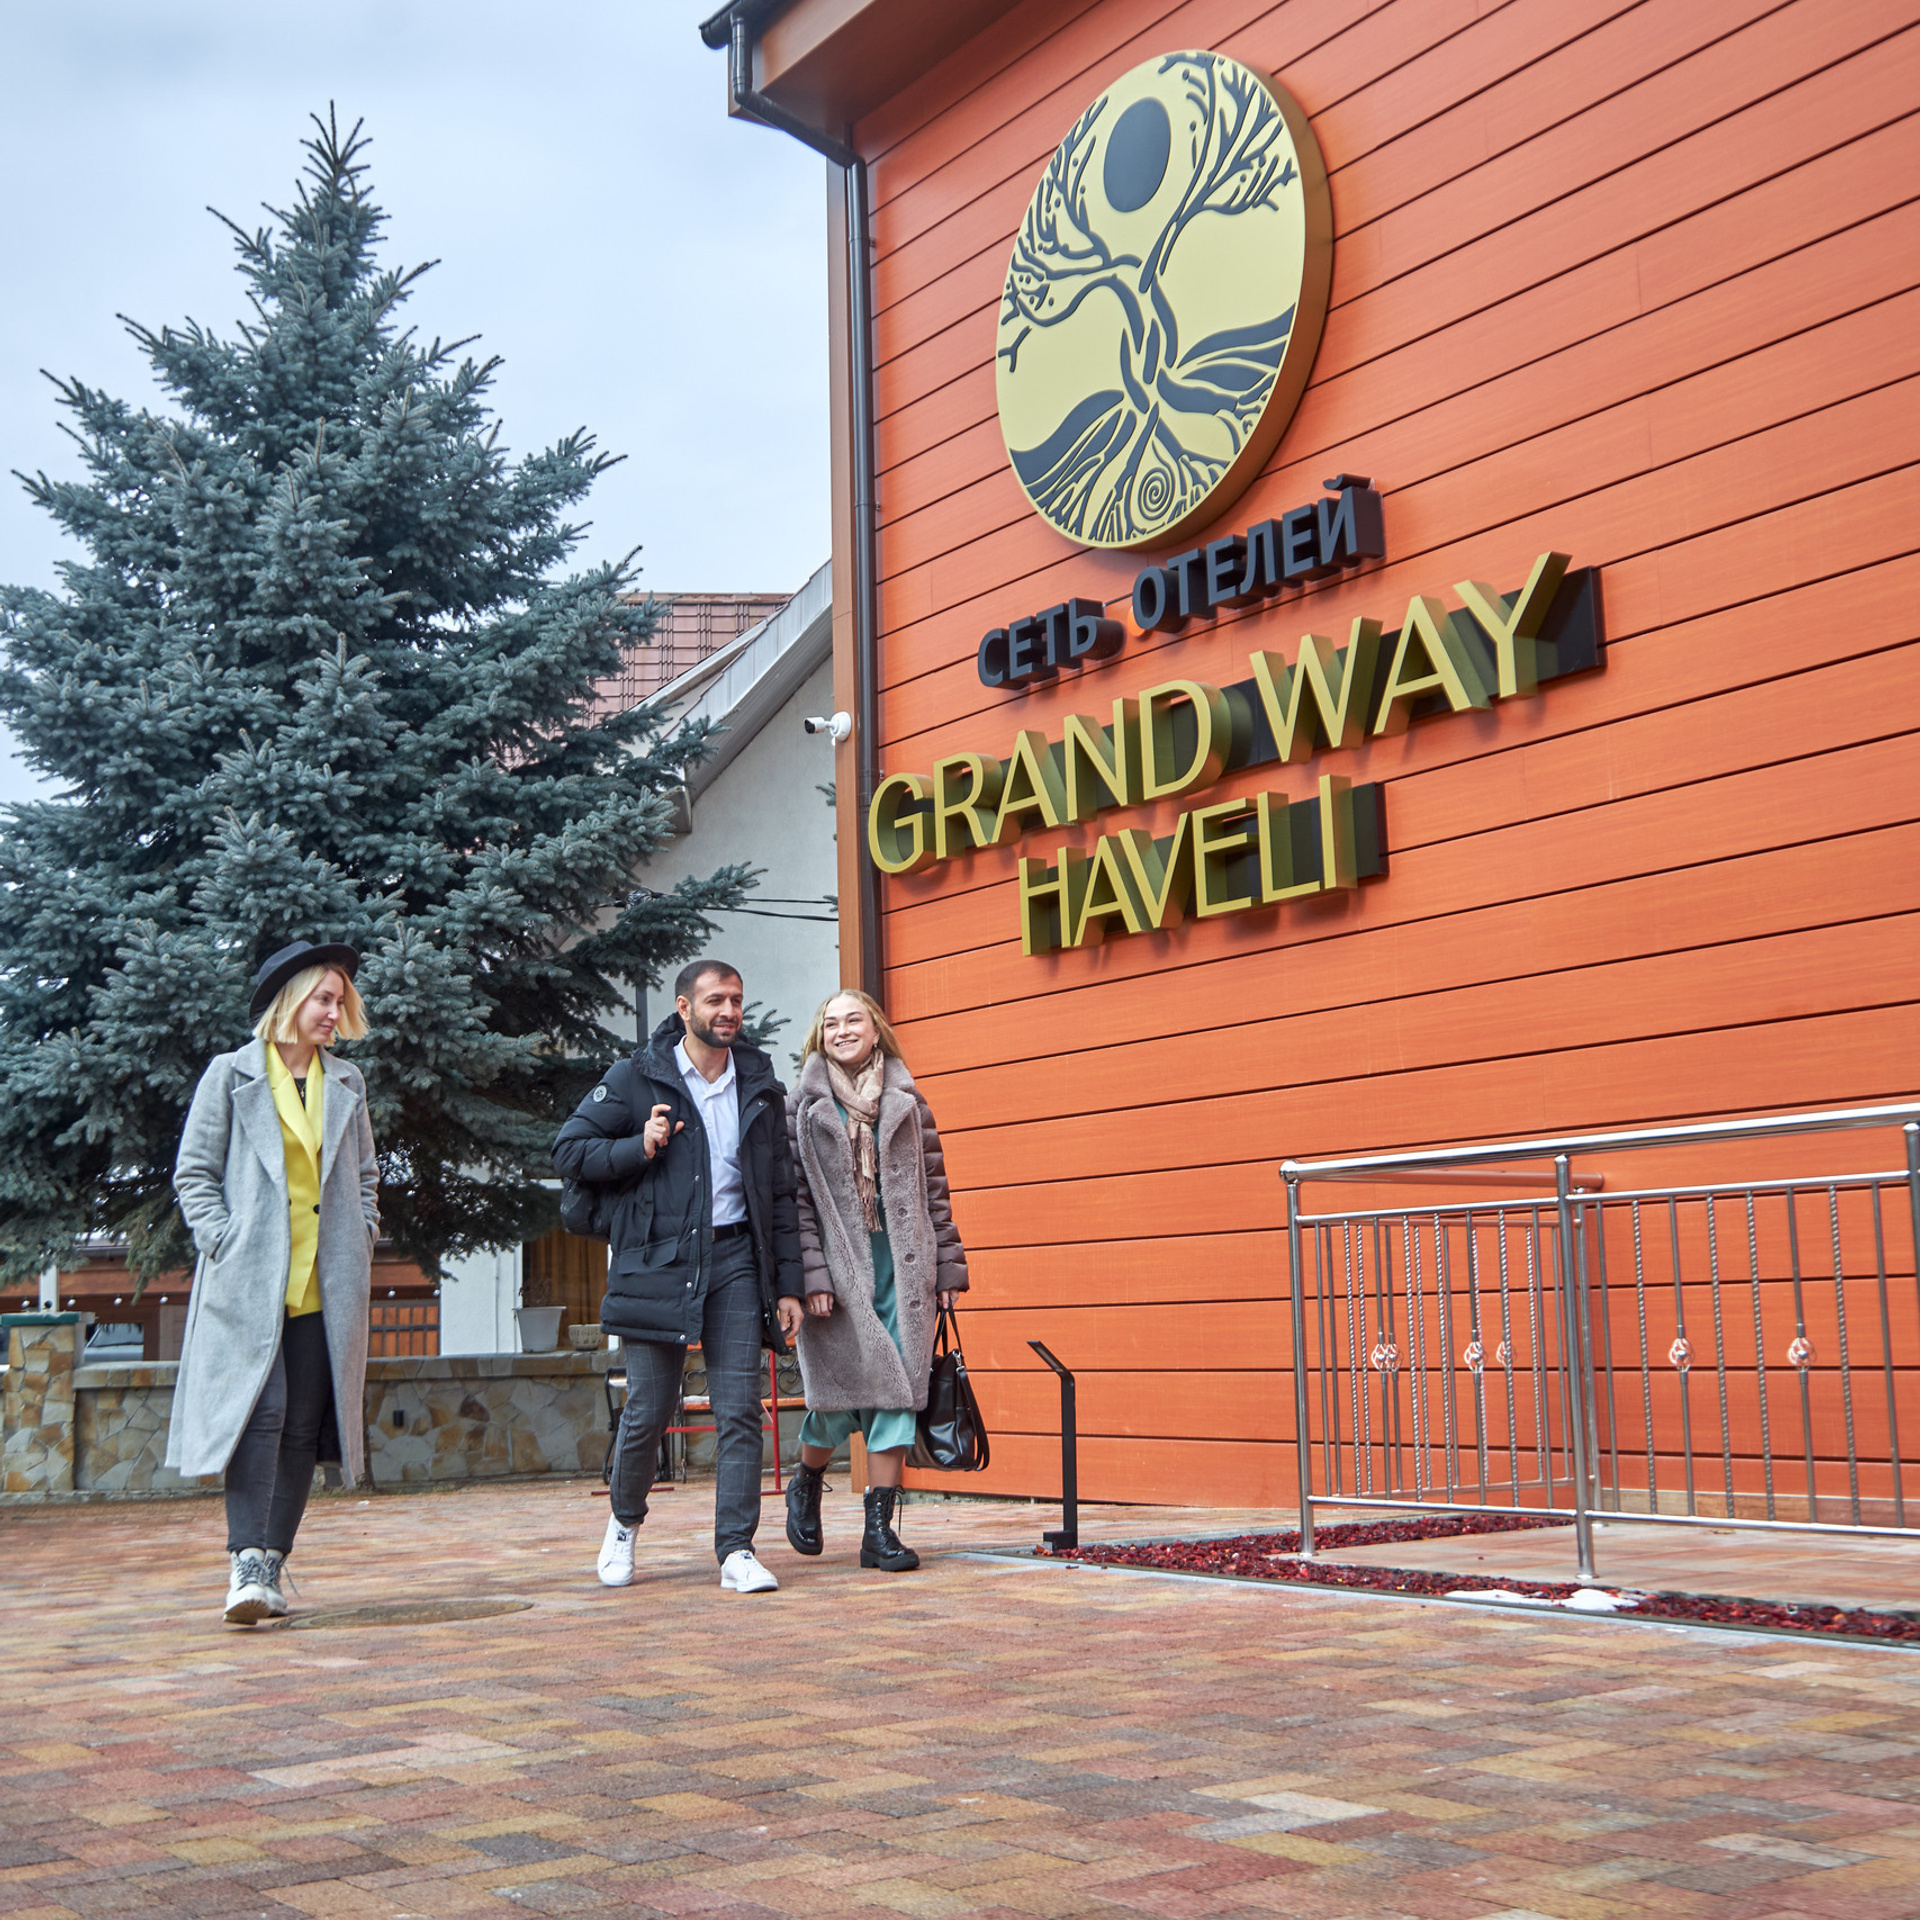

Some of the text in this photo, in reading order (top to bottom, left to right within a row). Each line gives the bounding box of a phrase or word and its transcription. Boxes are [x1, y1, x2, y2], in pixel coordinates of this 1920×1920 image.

[977, 473, 1374, 687] СЕТЬ ОТЕЛЕЙ
[867, 551, 1571, 874] GRAND WAY
[1019, 774, 1345, 956] HAVELI
